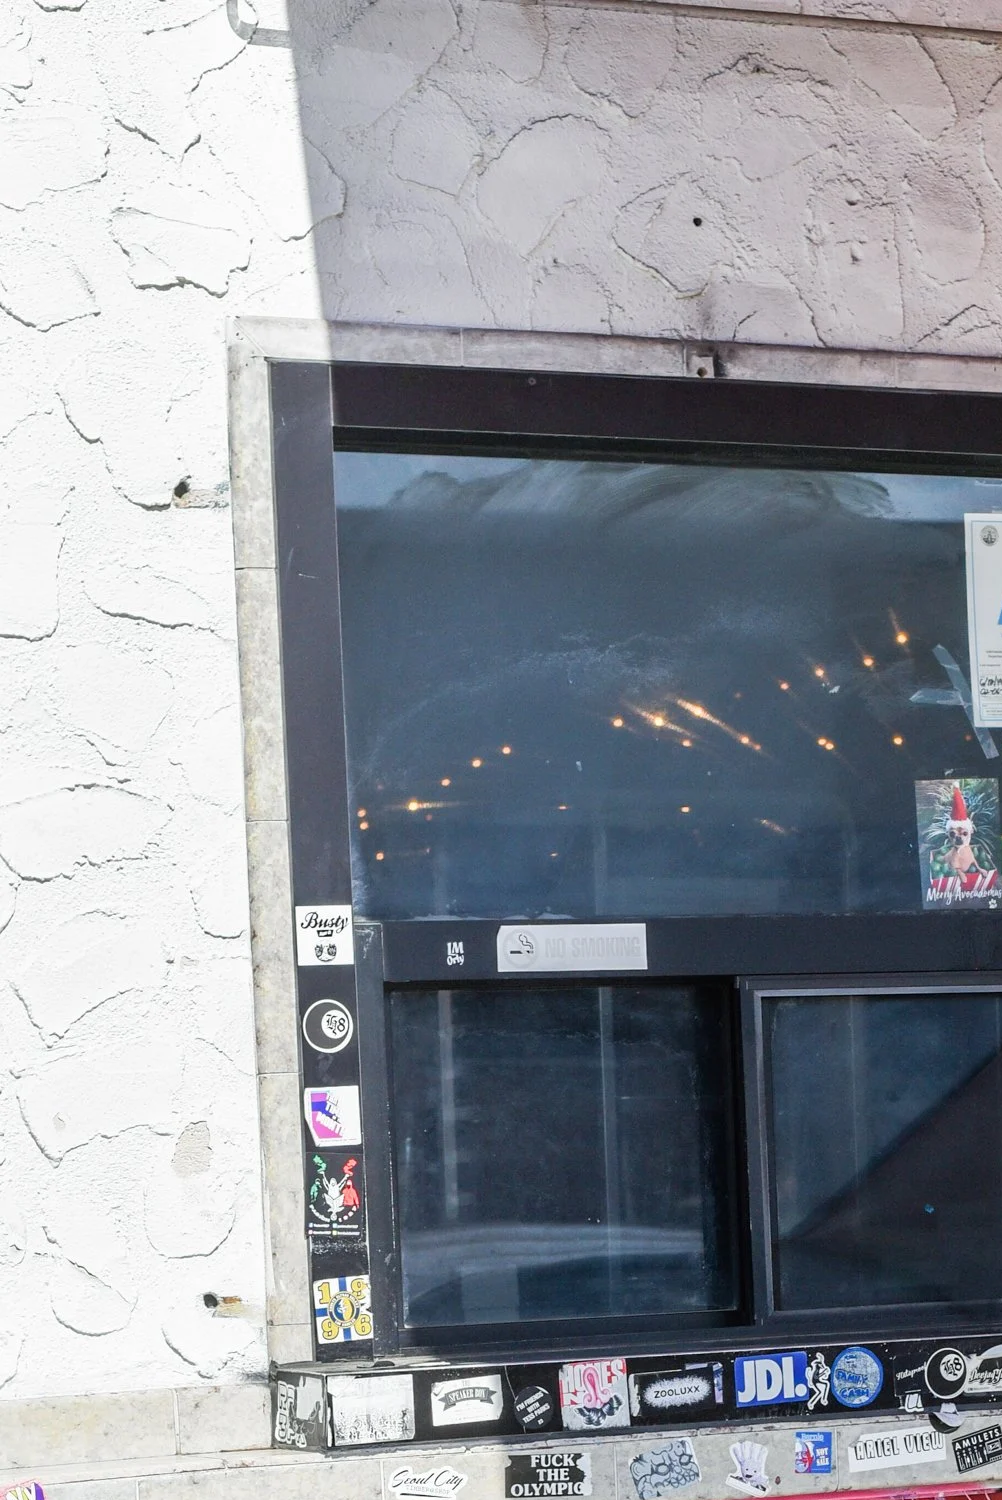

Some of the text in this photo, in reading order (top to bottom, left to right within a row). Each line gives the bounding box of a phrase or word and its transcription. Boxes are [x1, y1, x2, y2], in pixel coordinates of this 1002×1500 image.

[301, 911, 349, 934] Busty
[545, 936, 641, 958] NO SMOKING
[737, 1357, 807, 1403] JDI.
[449, 1387, 474, 1400] SPEAKER
[653, 1385, 700, 1399] ZOOLUXX
[855, 1431, 944, 1461] ARIEL VIEW
[954, 1429, 1000, 1451] AMULETS
[531, 1454, 575, 1468] FUCK
[434, 1469, 464, 1491] City
[536, 1468, 570, 1482] THE
